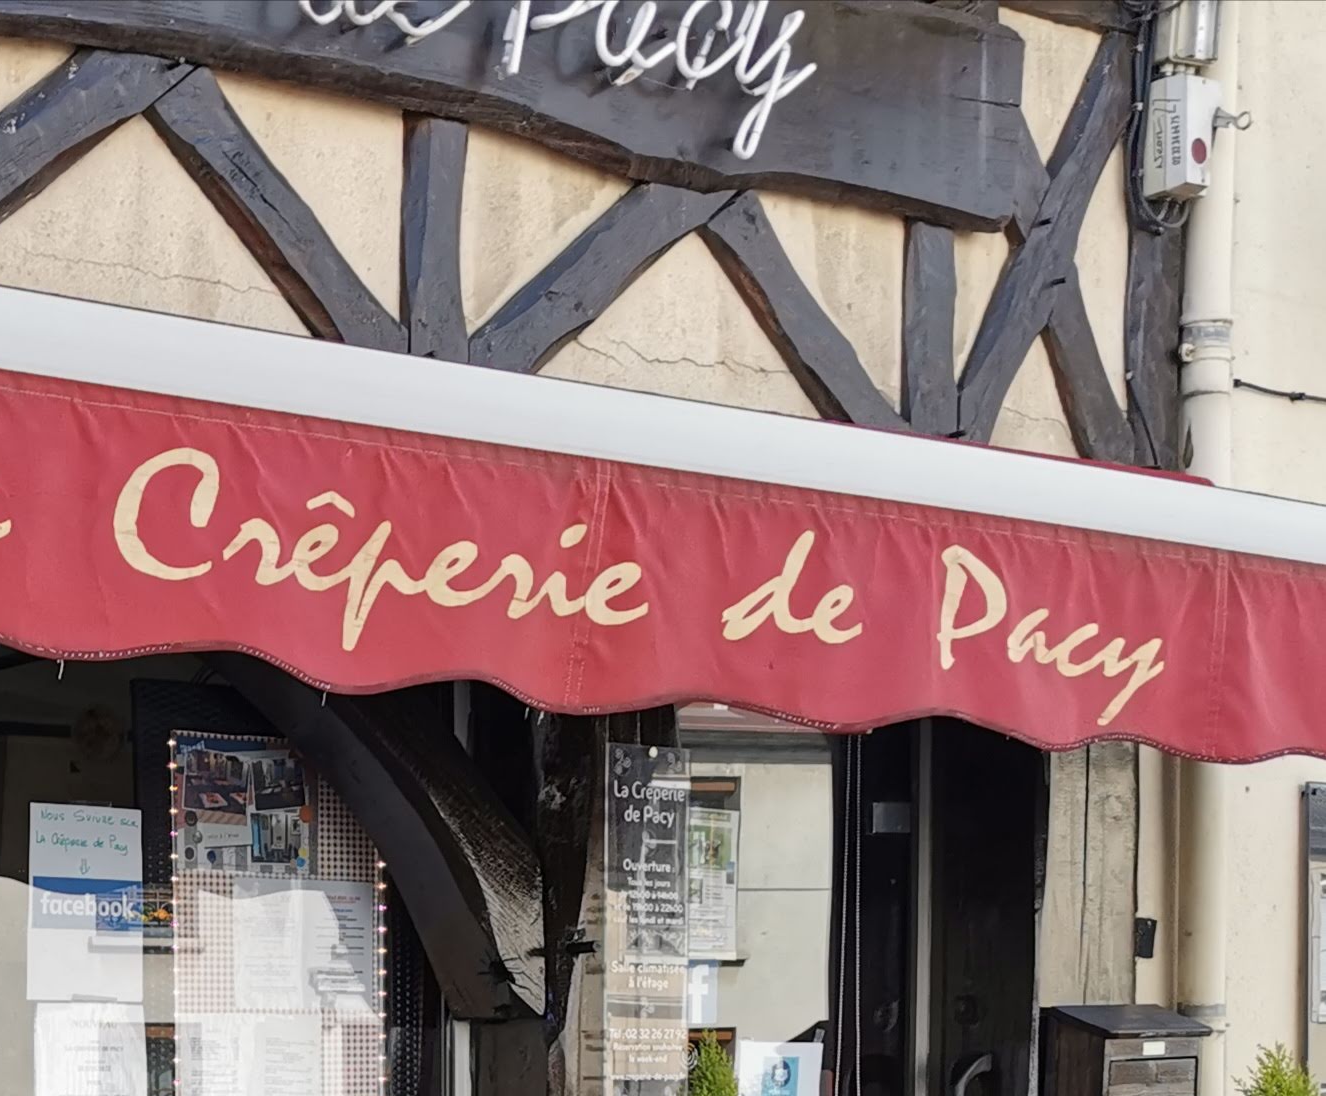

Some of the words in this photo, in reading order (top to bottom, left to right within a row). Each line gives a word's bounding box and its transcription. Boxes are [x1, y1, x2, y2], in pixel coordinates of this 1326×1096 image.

[113, 447, 650, 651] Crêperie
[722, 530, 863, 645] de
[936, 544, 1166, 727] Pacy
[614, 779, 629, 798] La
[624, 804, 641, 823] de
[643, 805, 675, 828] Pacy
[40, 891, 135, 918] facebook
